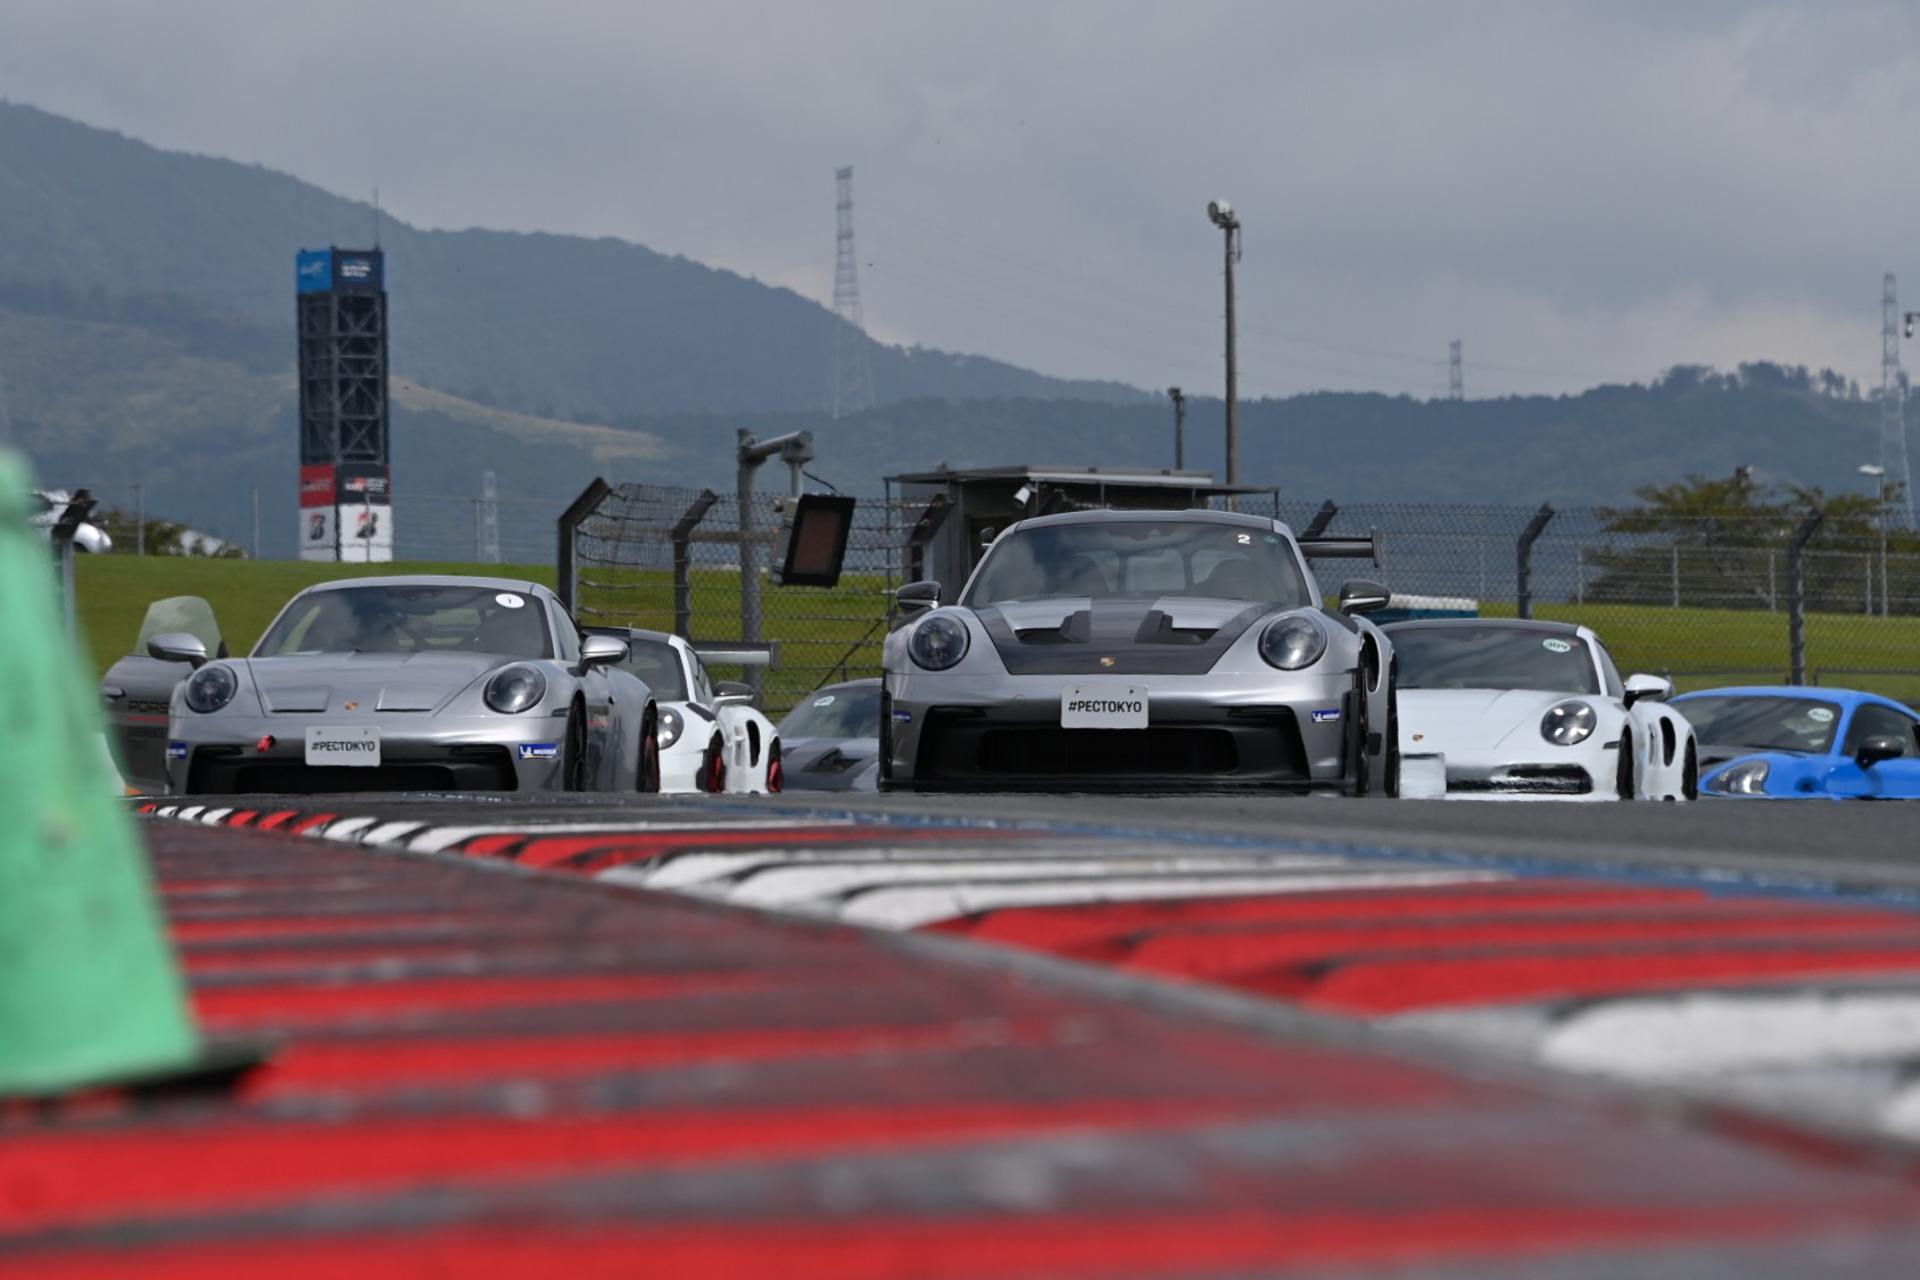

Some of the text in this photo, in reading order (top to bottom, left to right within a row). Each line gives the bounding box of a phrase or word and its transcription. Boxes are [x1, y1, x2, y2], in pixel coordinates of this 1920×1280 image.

[1237, 533, 1250, 545] 2
[1068, 700, 1142, 713] #PECTOKYO
[311, 741, 375, 752] #PECTOKYO
